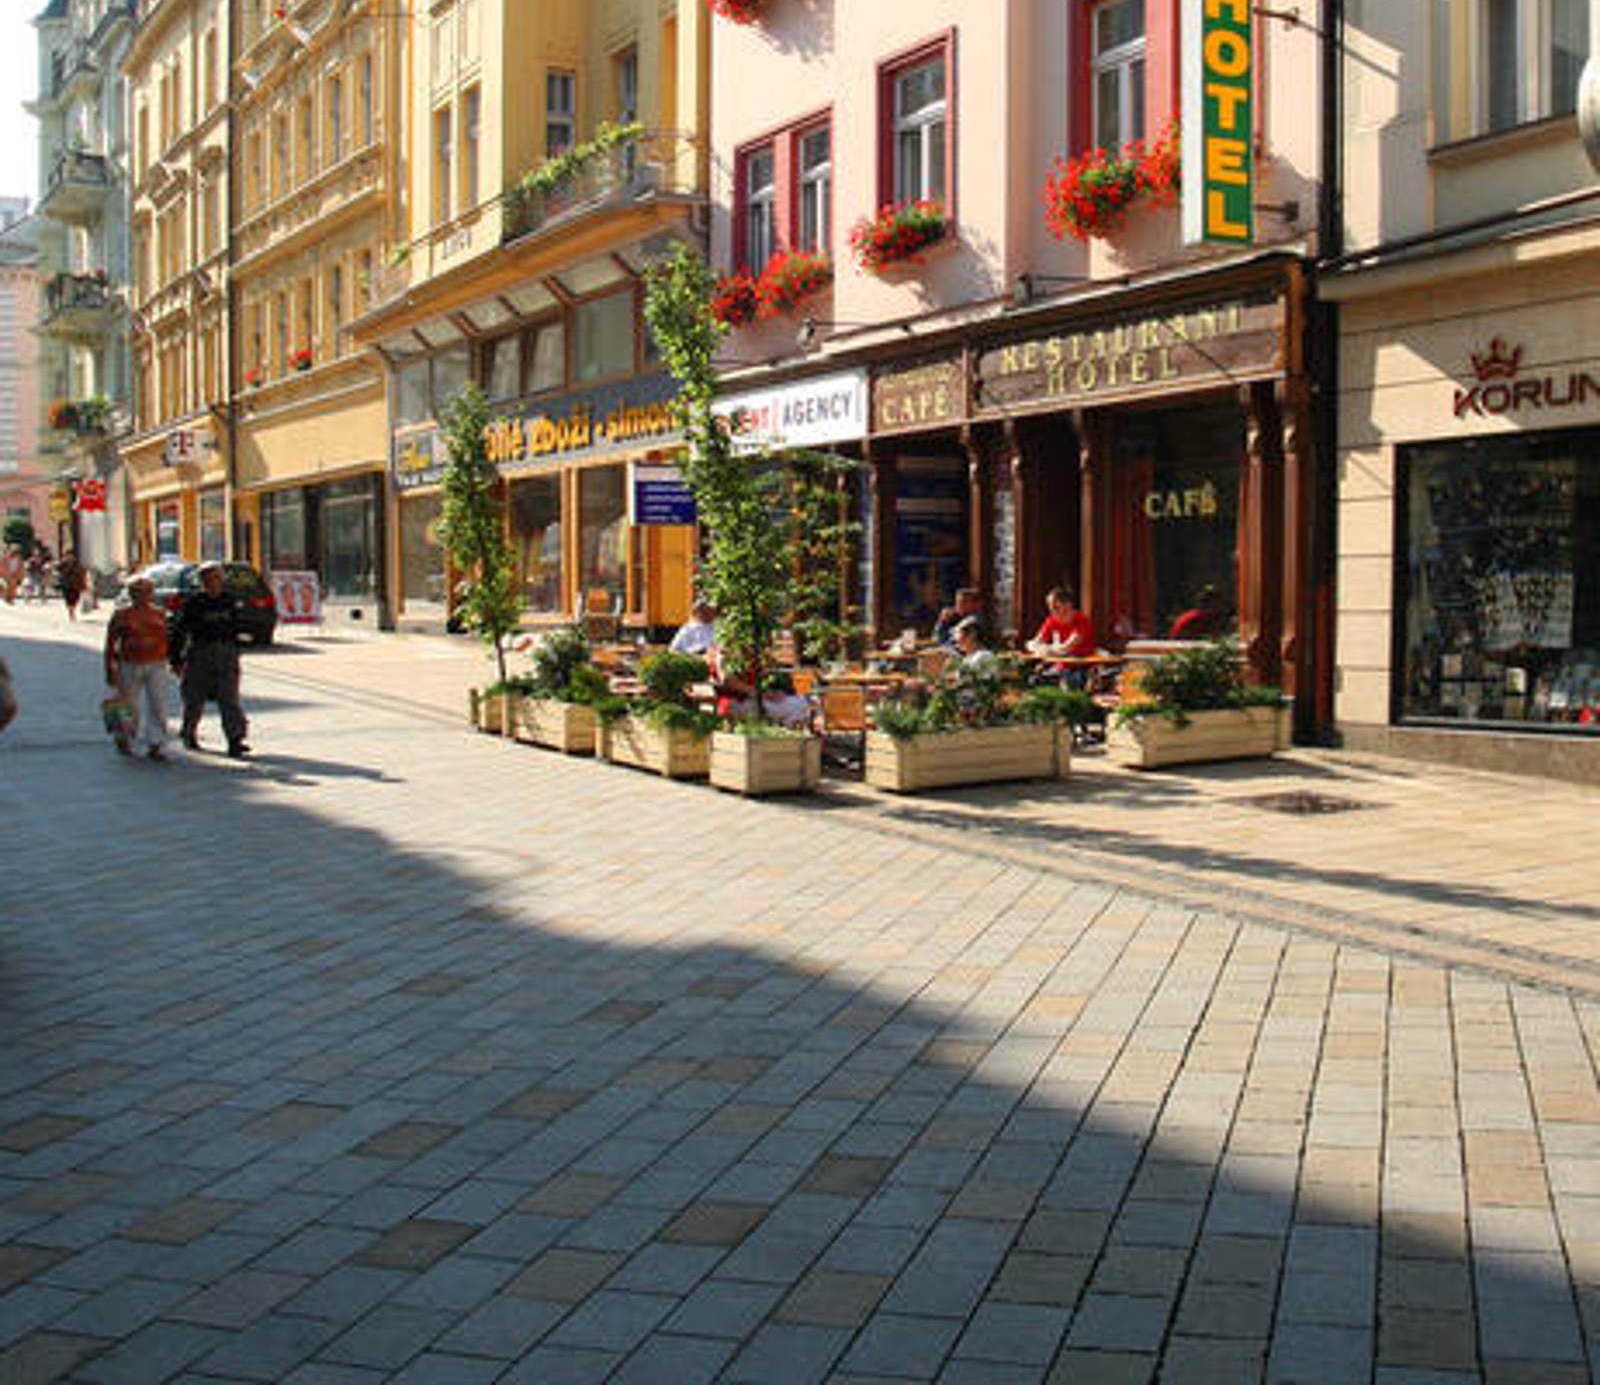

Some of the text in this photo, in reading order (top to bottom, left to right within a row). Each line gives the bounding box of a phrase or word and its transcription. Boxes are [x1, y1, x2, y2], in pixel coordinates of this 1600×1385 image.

[1000, 306, 1242, 375] RESTAURANT
[1048, 347, 1180, 395] HOTEL
[783, 390, 853, 427] AGENCY
